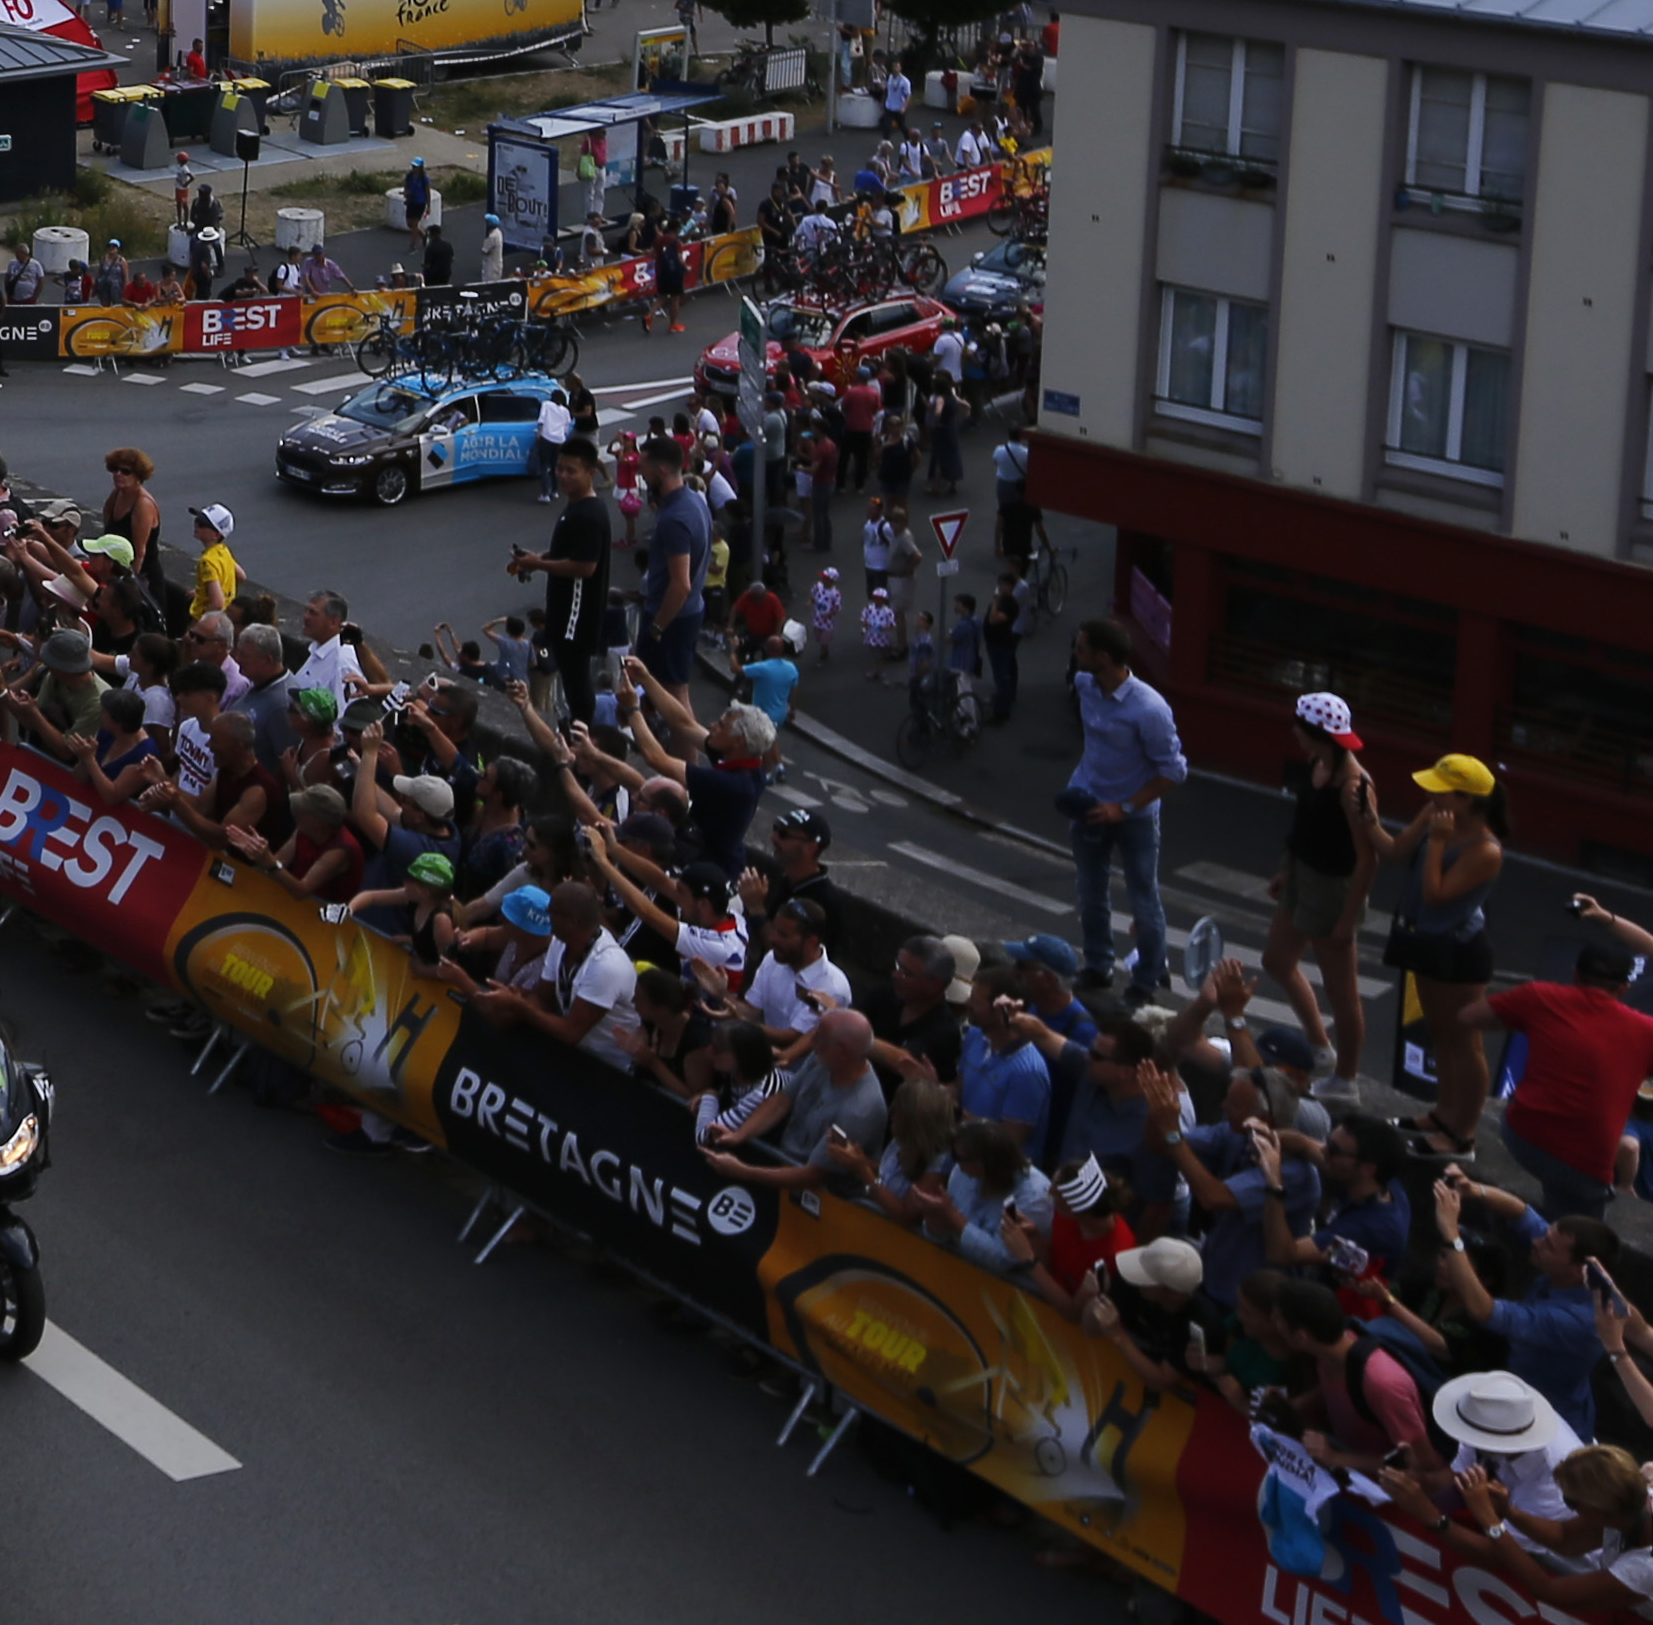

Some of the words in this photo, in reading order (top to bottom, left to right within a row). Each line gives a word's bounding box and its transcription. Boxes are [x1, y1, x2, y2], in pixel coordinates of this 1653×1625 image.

[497, 175, 516, 195] DE
[940, 171, 991, 204] BREST
[202, 304, 282, 334] BREST
[202, 332, 232, 347] LIFE
[460, 448, 530, 463] MONDIAL
[499, 435, 519, 447] LA
[221, 952, 274, 1000] TOUR
[450, 1067, 701, 1247] BRETAGNE
[845, 1309, 928, 1374] TOUR
